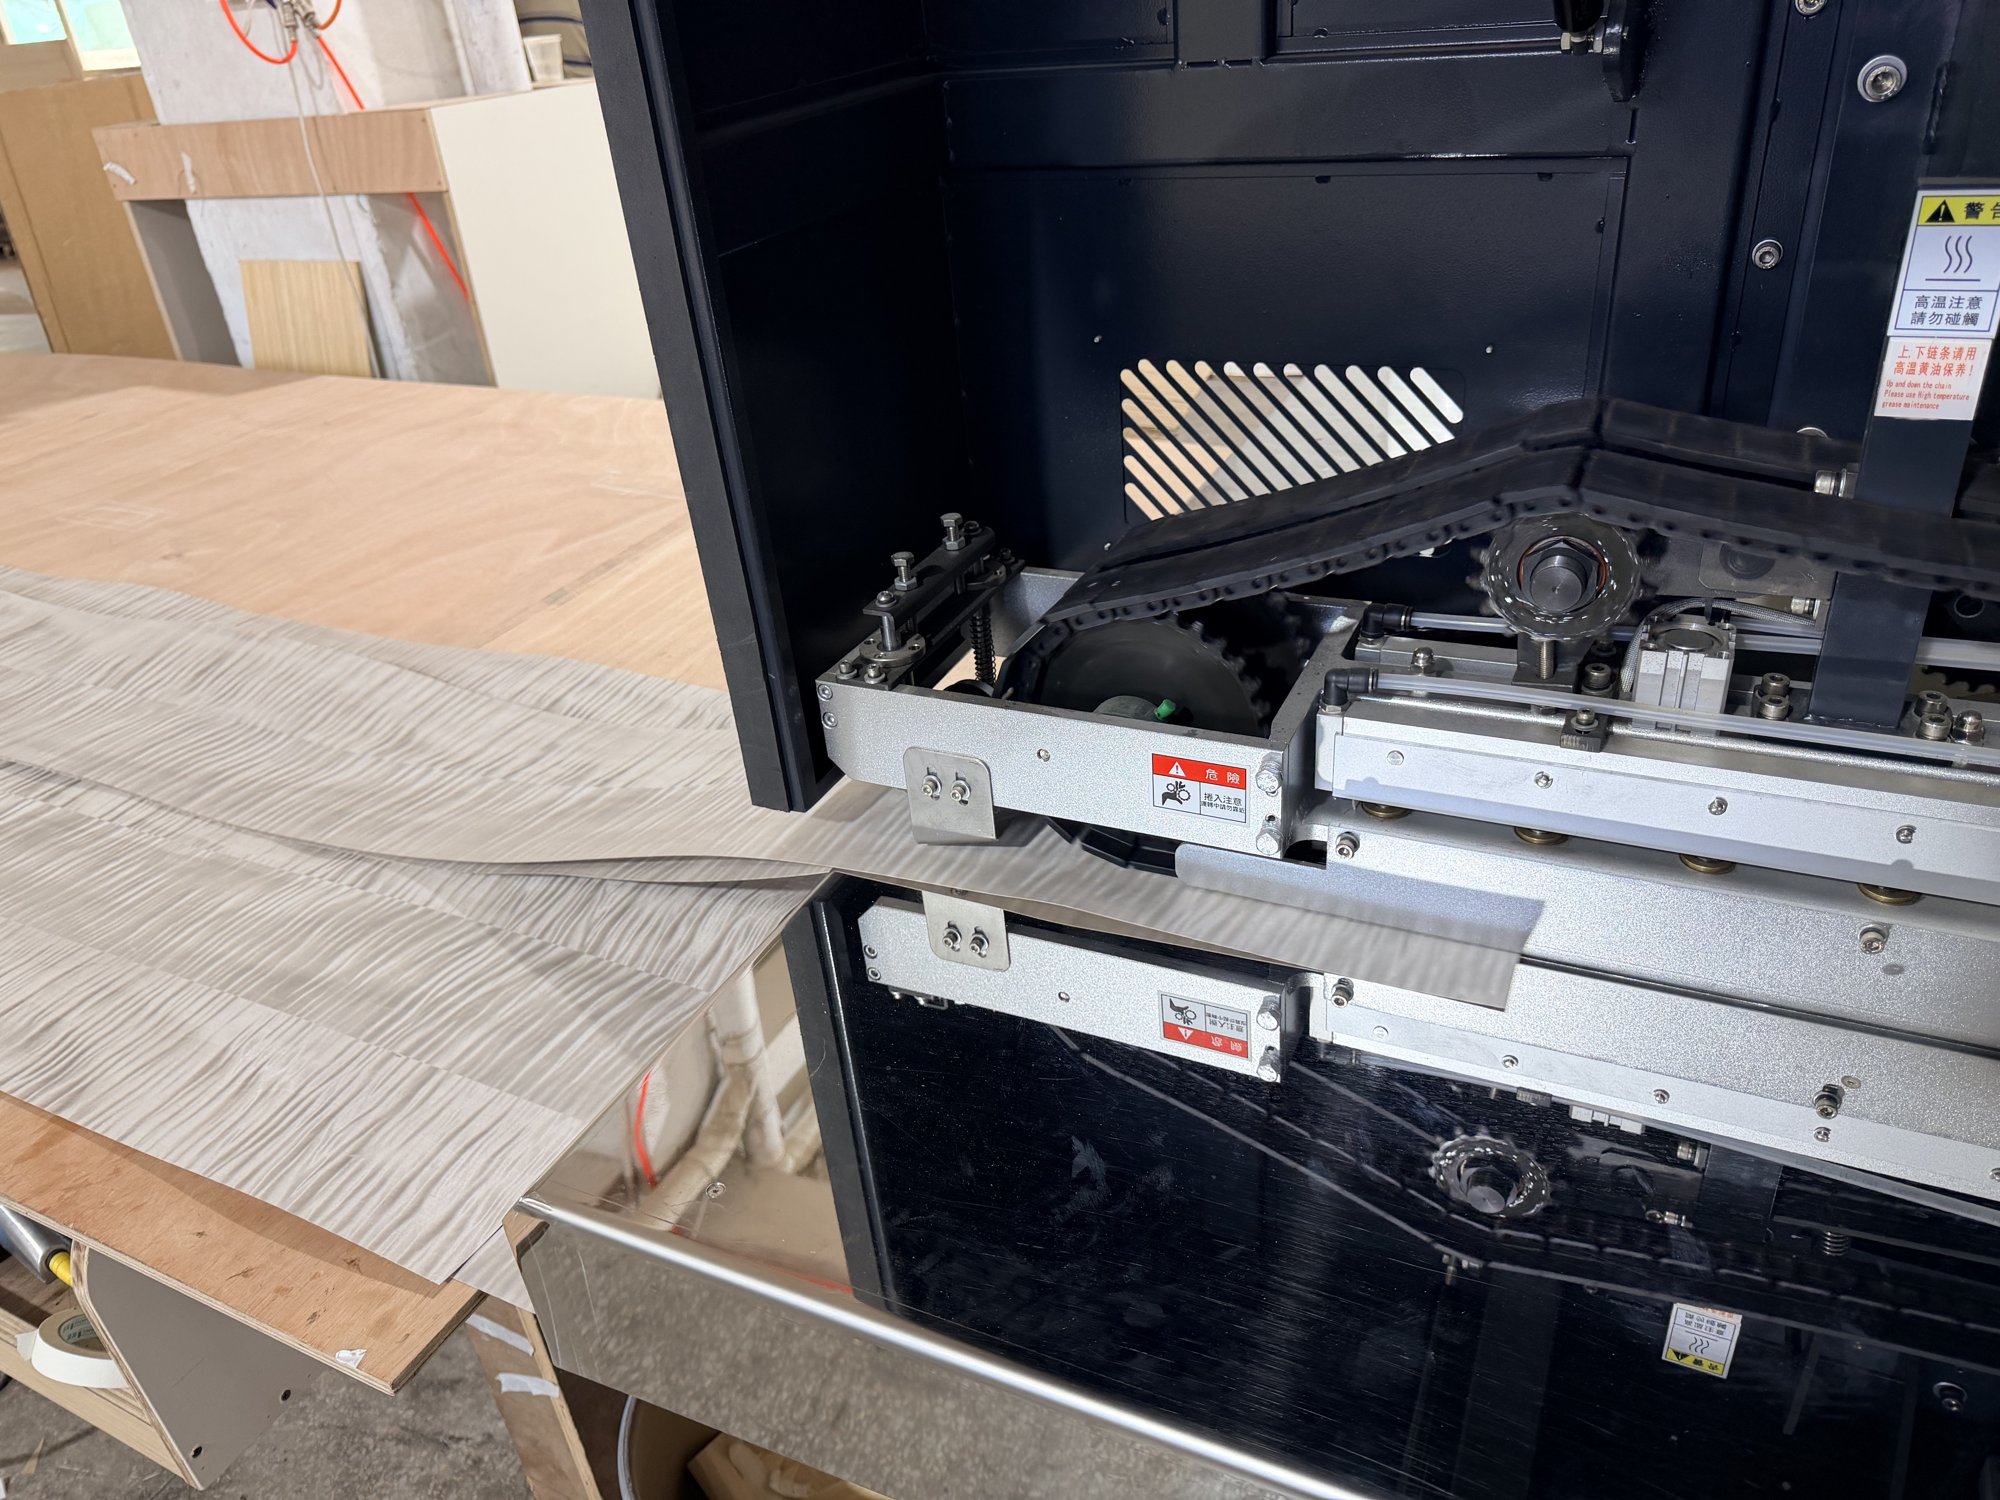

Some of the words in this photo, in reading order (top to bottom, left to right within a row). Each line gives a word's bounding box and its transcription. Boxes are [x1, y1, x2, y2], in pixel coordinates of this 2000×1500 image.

[1910, 311, 1980, 326] 請勿碰觸
[1886, 379, 1894, 388] Up
[1895, 380, 1906, 388] and
[1907, 380, 1921, 388] down
[1923, 381, 1933, 389] the
[1934, 382, 1952, 390] chain
[1884, 389, 1904, 398] Please
[1905, 391, 1916, 399] use
[1933, 392, 1970, 401] temperature
[1881, 401, 1902, 409] grease
[1903, 401, 1940, 410] maintenance
[1205, 768, 1240, 785] 危險
